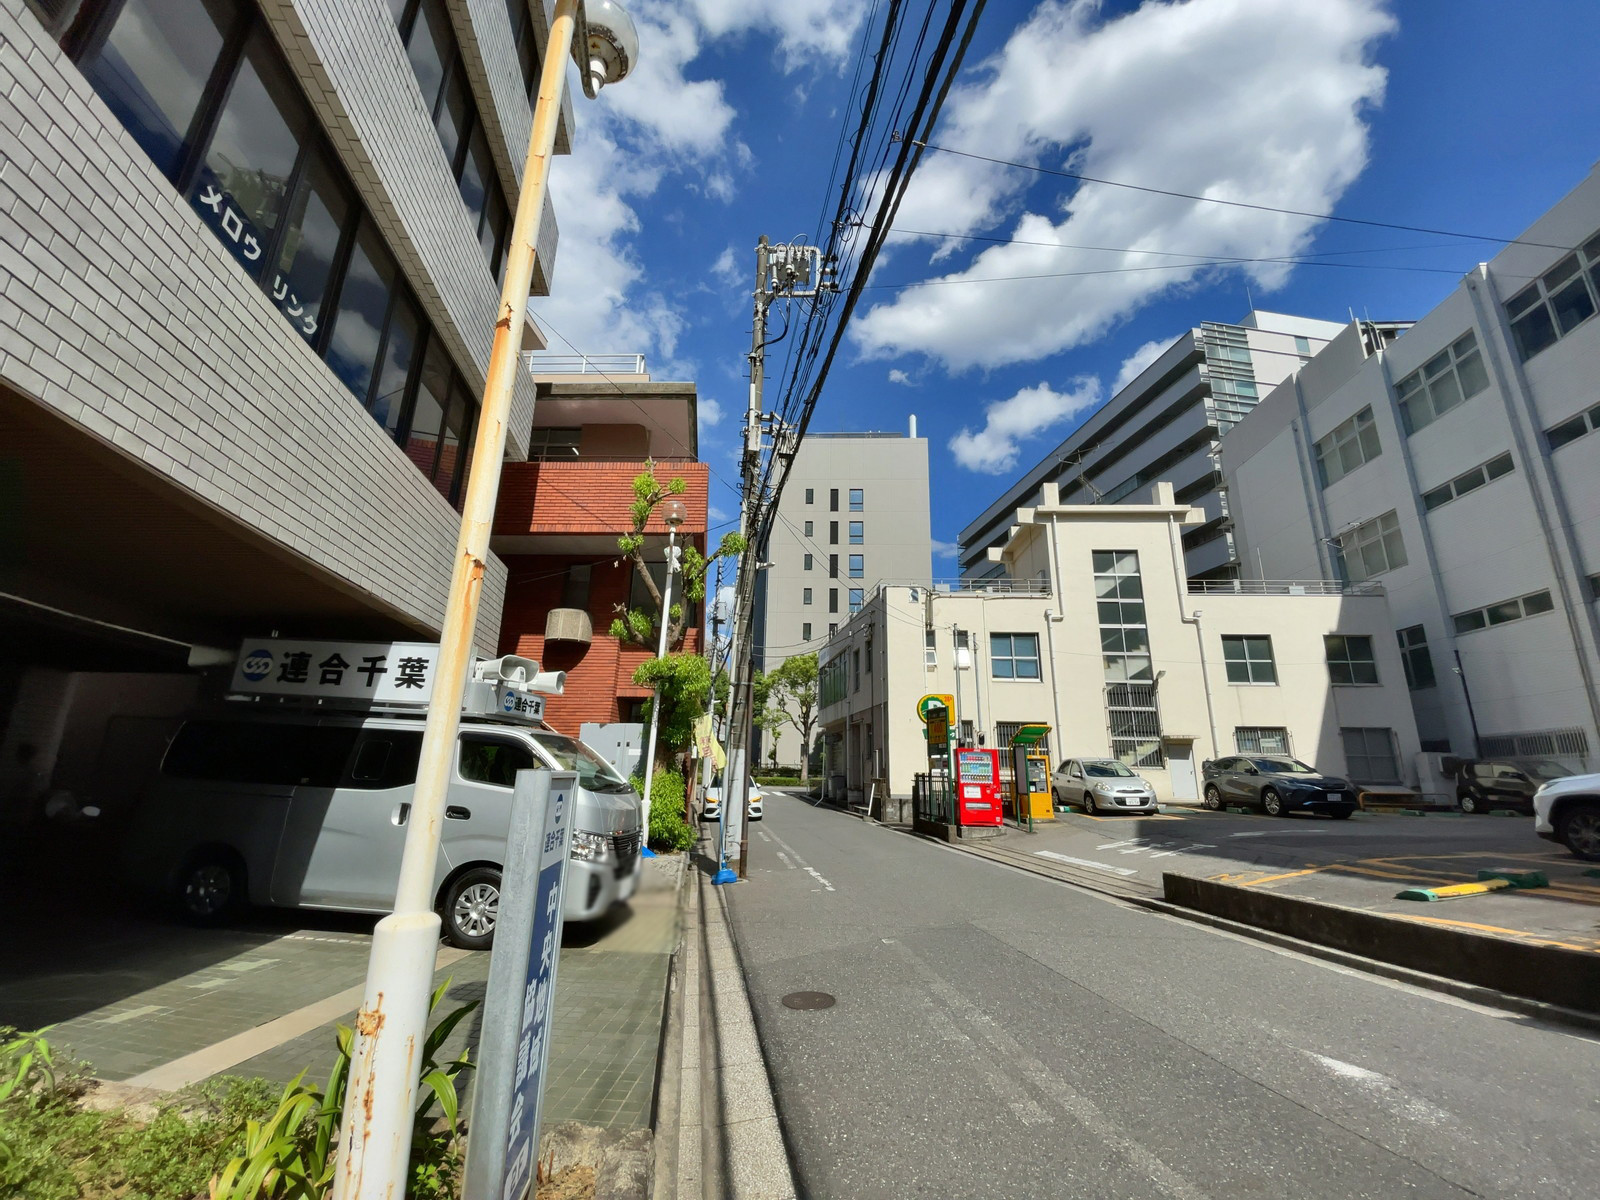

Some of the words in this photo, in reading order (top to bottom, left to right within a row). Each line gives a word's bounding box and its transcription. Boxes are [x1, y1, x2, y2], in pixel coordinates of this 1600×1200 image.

[200, 186, 262, 260] メロウ
[273, 275, 318, 335] リンク
[277, 651, 429, 689] 連合千葉
[514, 696, 541, 715] 連合千葉
